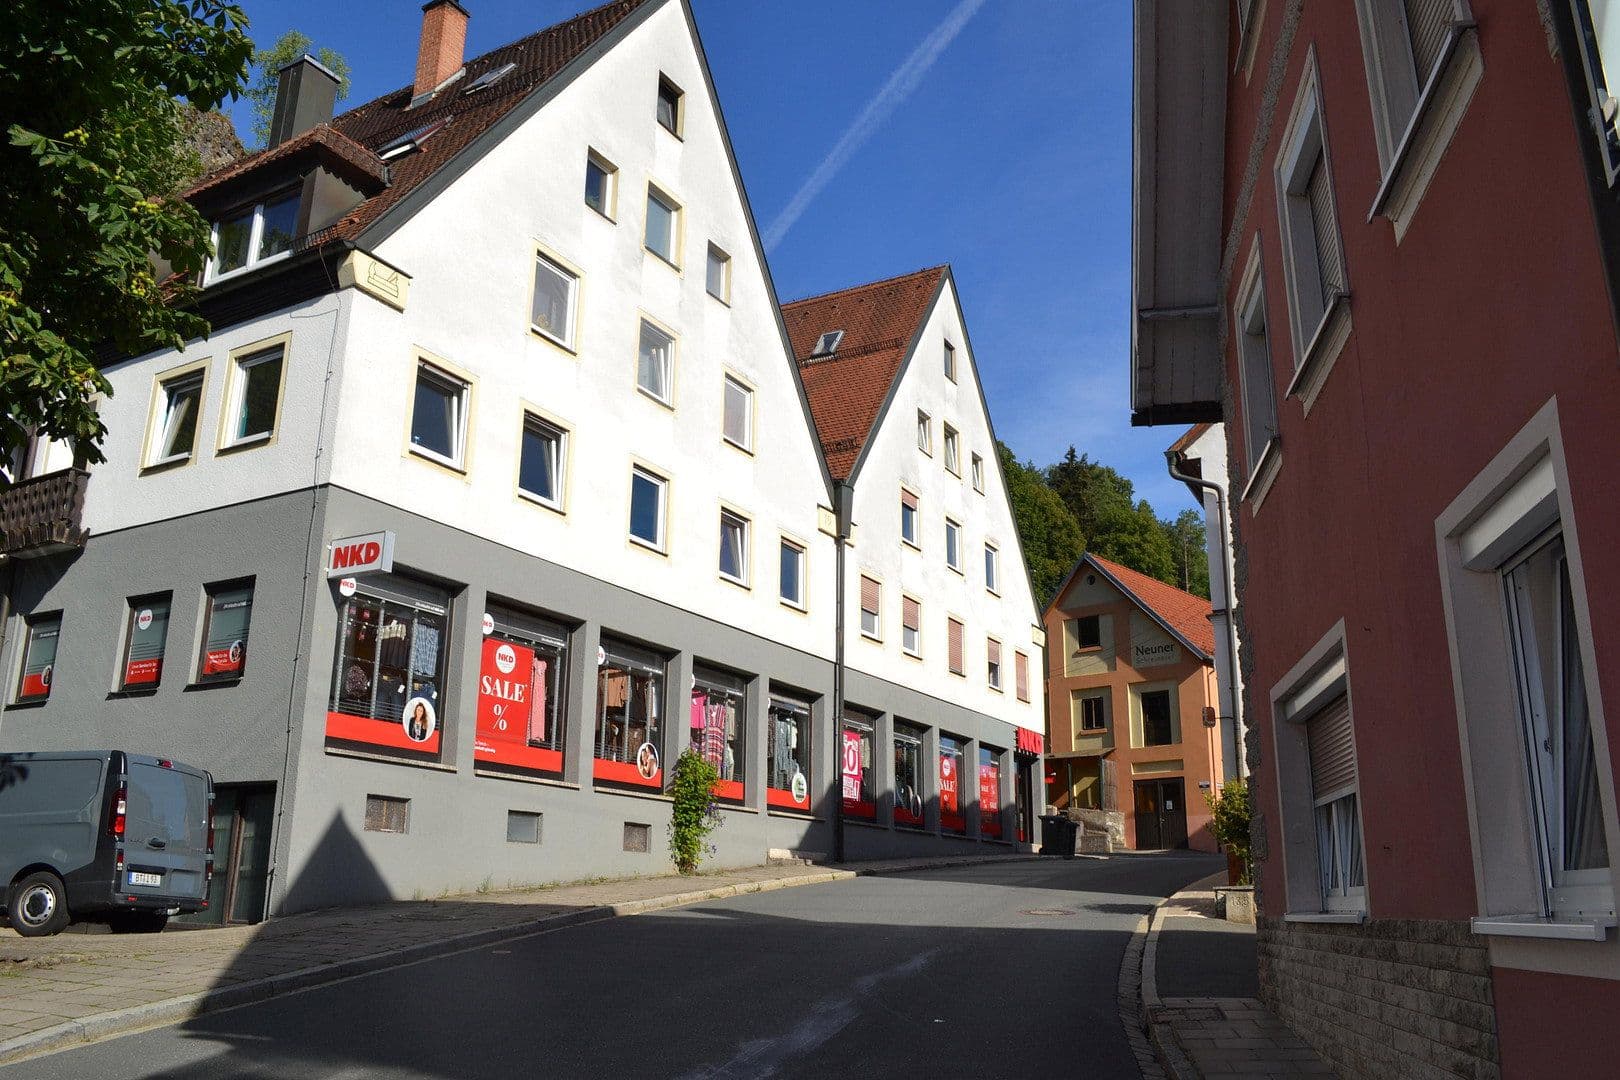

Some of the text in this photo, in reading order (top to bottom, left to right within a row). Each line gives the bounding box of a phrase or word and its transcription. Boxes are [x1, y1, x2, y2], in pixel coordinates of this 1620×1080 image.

[332, 541, 380, 569] NKD
[1136, 644, 1174, 656] Neuner
[498, 652, 514, 663] NKD
